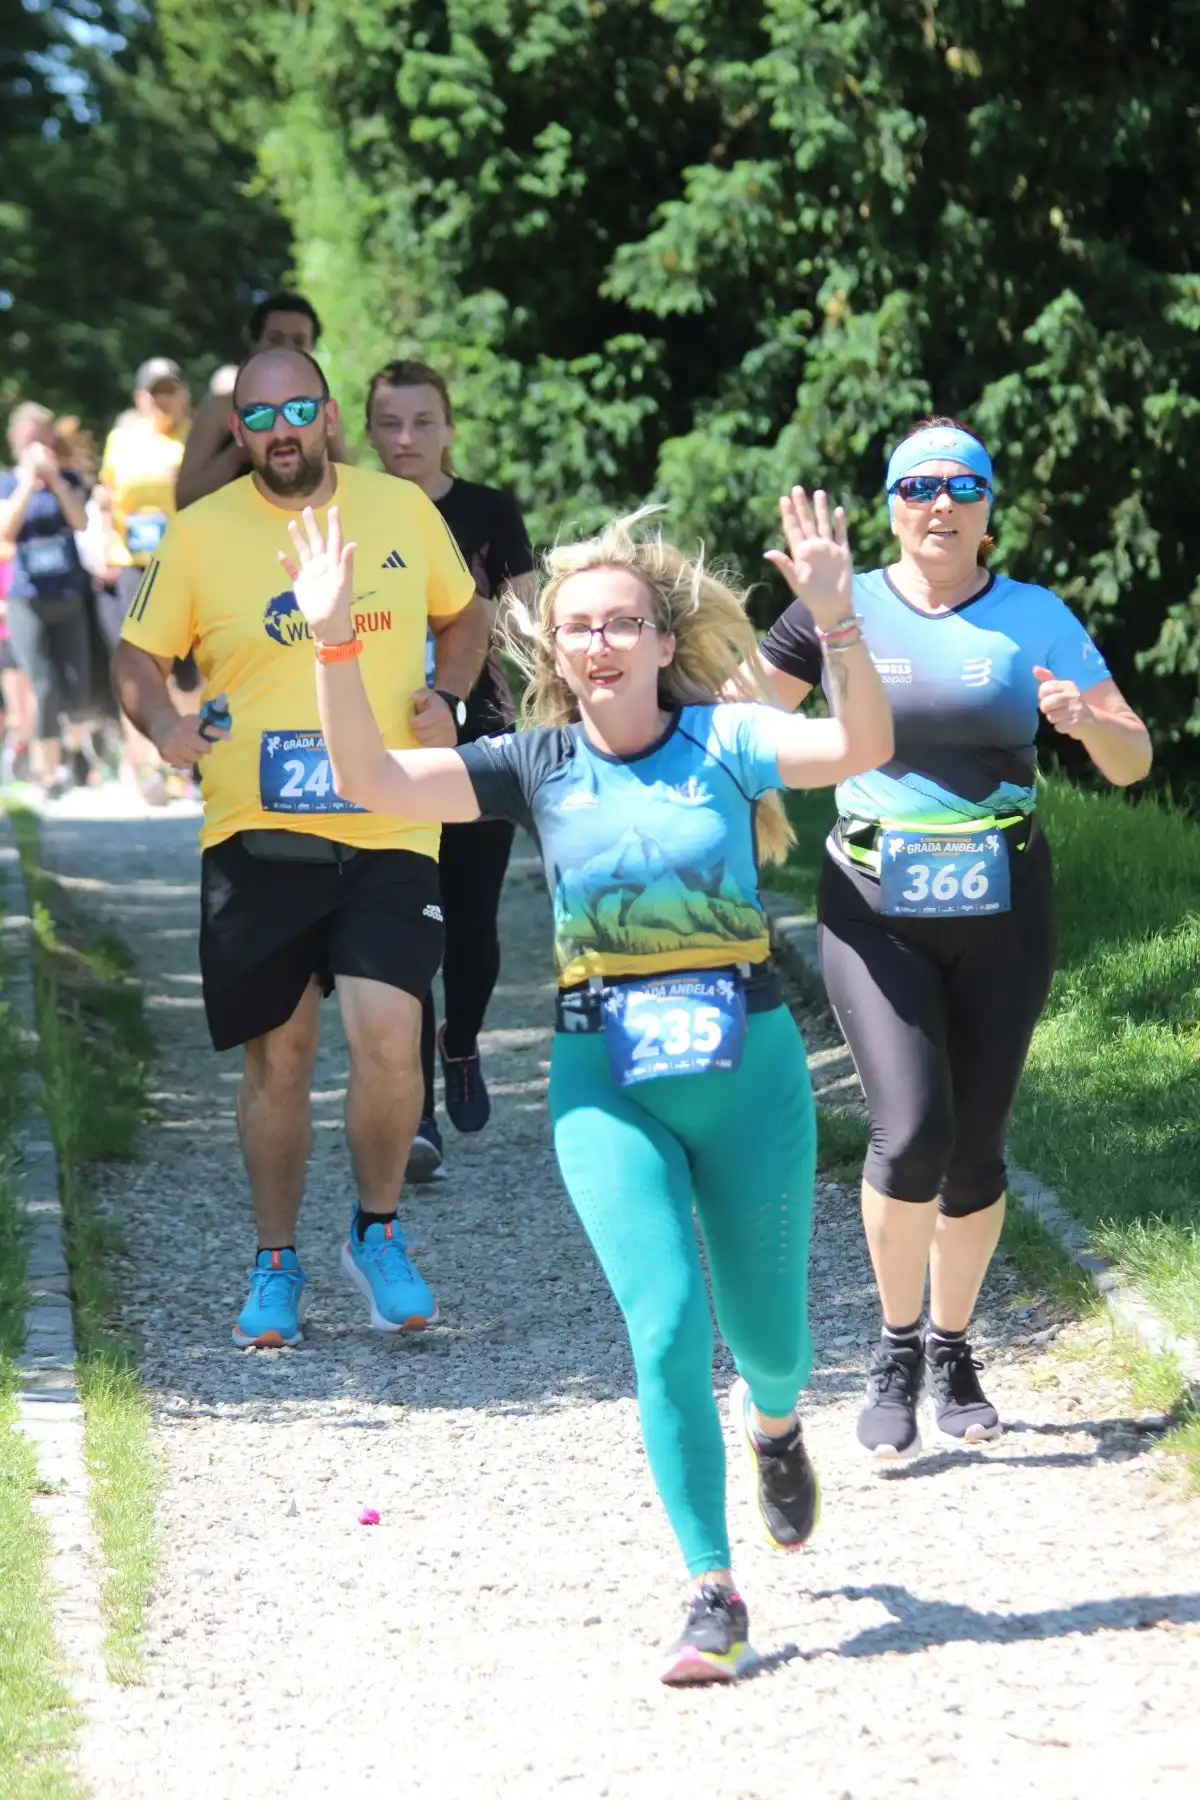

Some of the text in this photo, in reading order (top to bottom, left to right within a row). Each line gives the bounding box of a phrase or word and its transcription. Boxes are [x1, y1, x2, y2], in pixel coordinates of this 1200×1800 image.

[355, 611, 391, 633] RUN
[283, 737, 315, 751] GRADA
[280, 759, 331, 797] 24
[907, 842, 942, 854] GRADA
[902, 861, 989, 901] 366
[631, 1007, 722, 1060] 235
